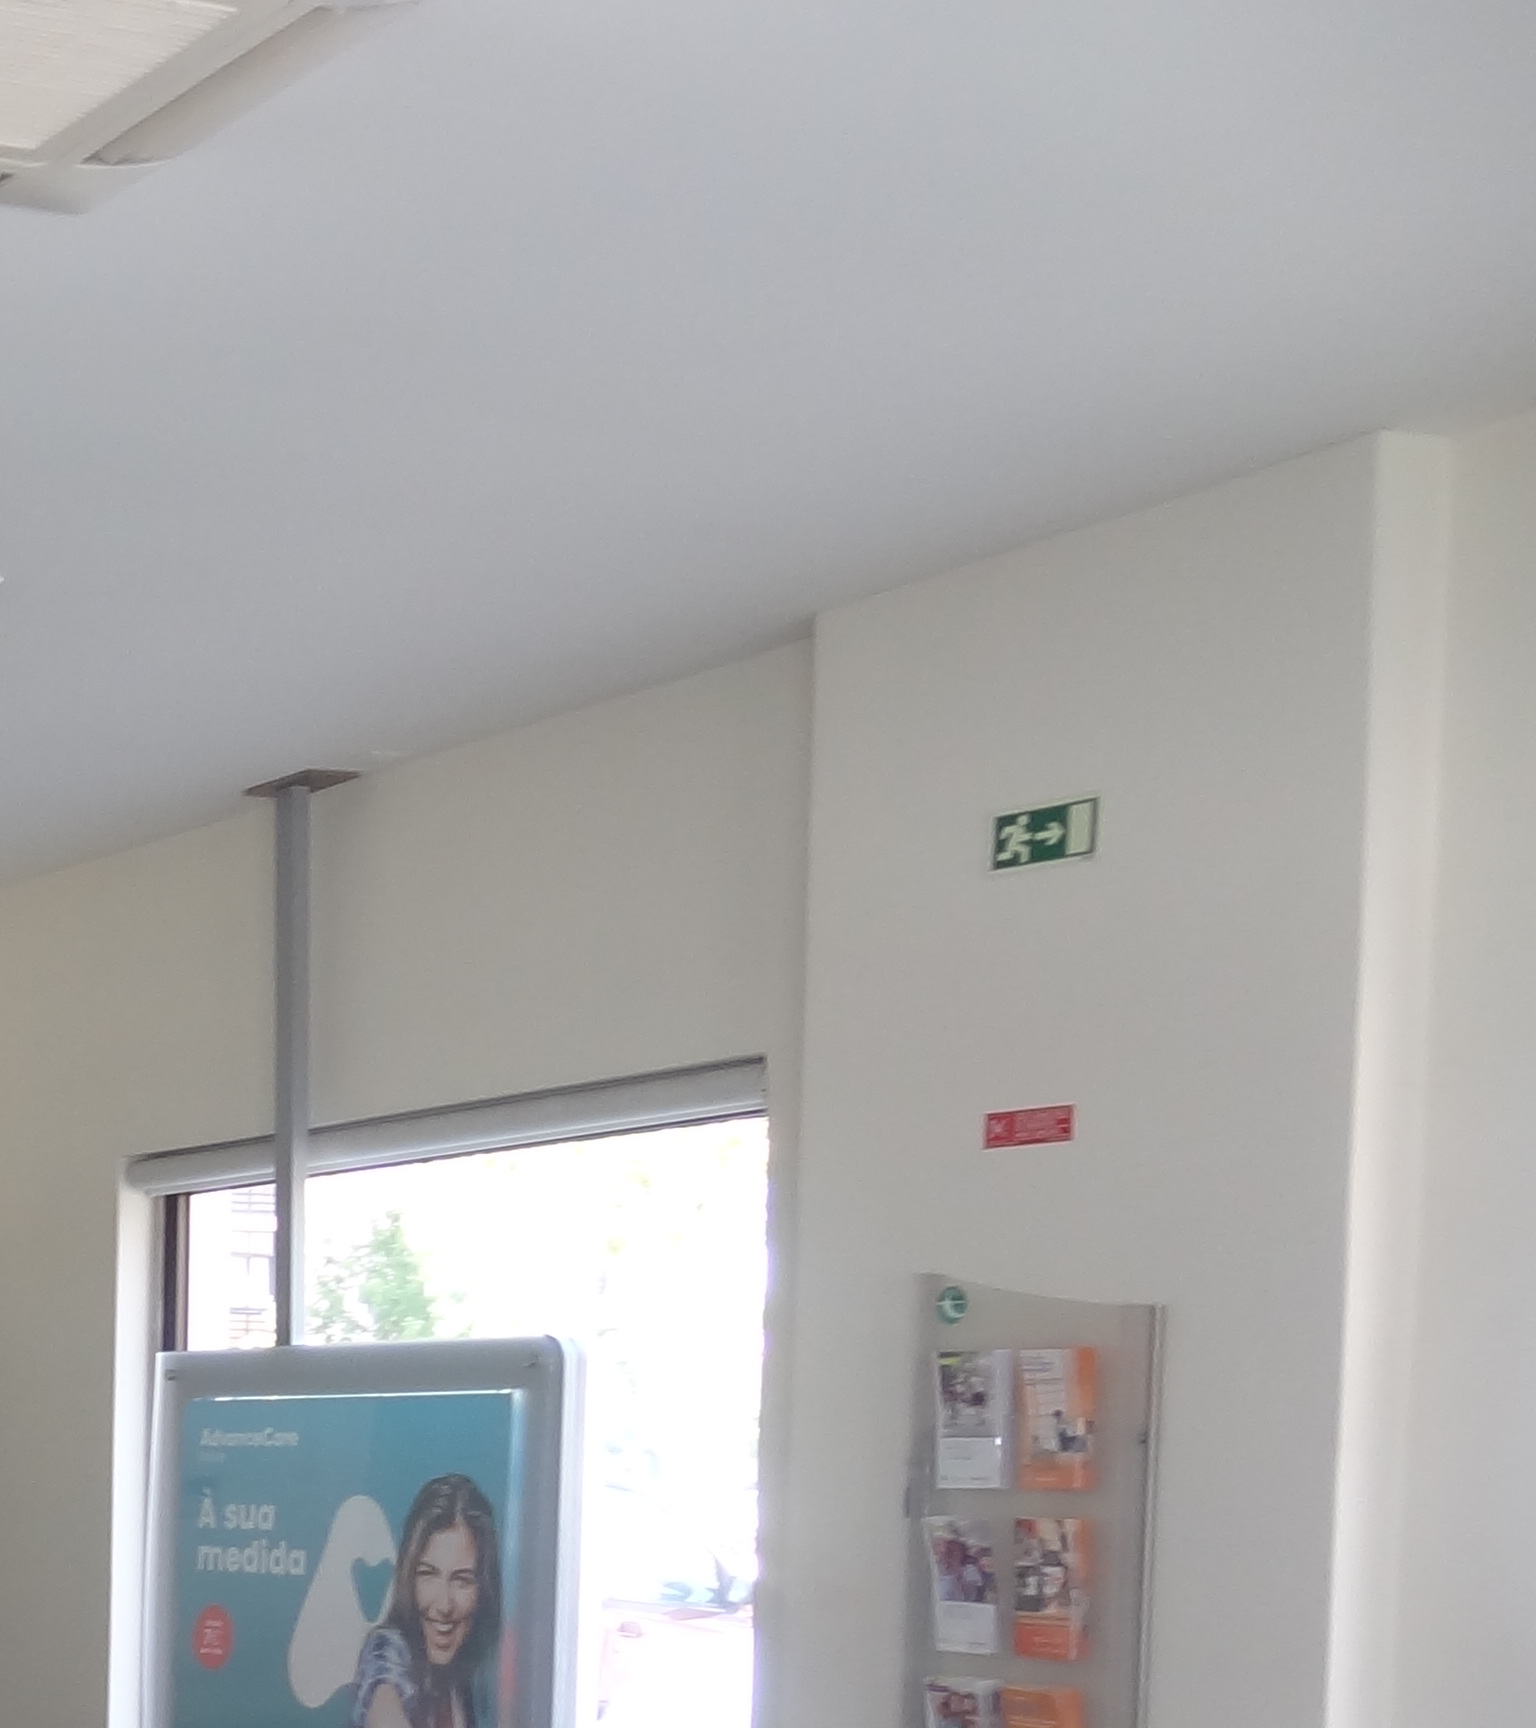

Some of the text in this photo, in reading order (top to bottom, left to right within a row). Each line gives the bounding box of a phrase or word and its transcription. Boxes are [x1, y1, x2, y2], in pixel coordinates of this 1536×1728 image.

[197, 1487, 276, 1531] À sua
[196, 1537, 307, 1576] medida
